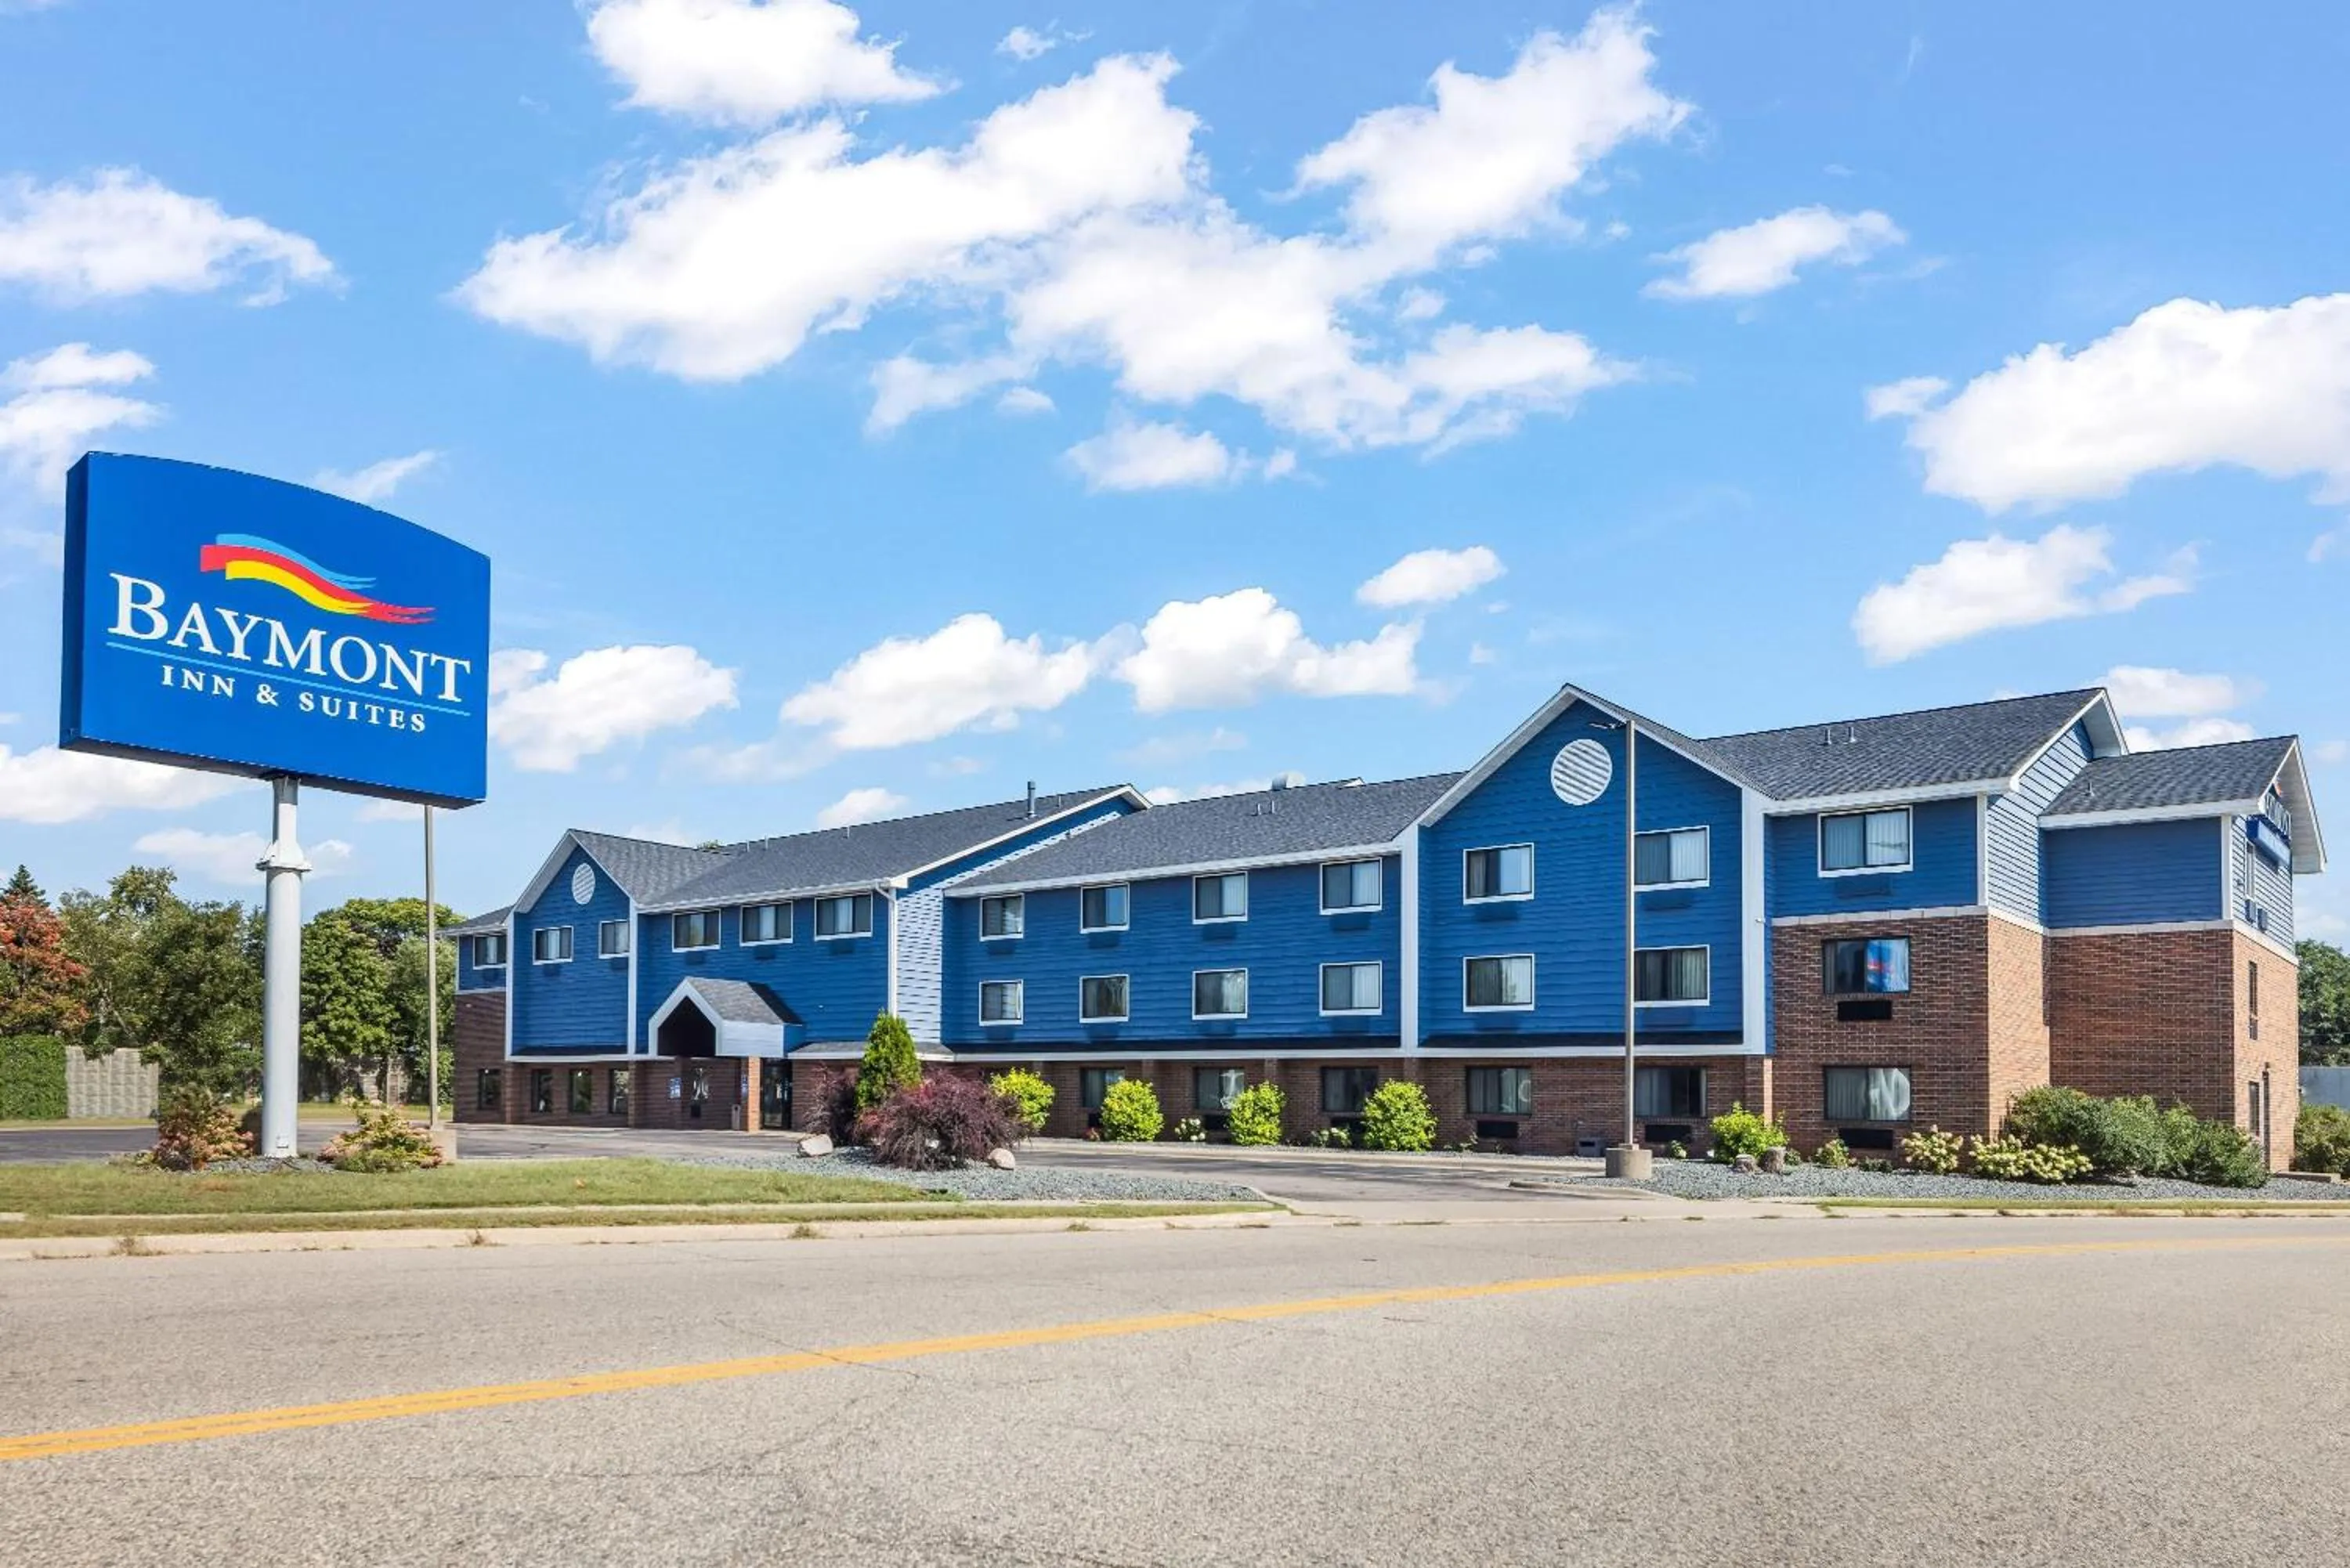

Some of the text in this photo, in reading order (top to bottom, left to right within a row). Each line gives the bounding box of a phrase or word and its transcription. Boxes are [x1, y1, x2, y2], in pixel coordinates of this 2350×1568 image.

[108, 573, 471, 703] BAYMONT
[161, 665, 426, 732] INN & SUITES
